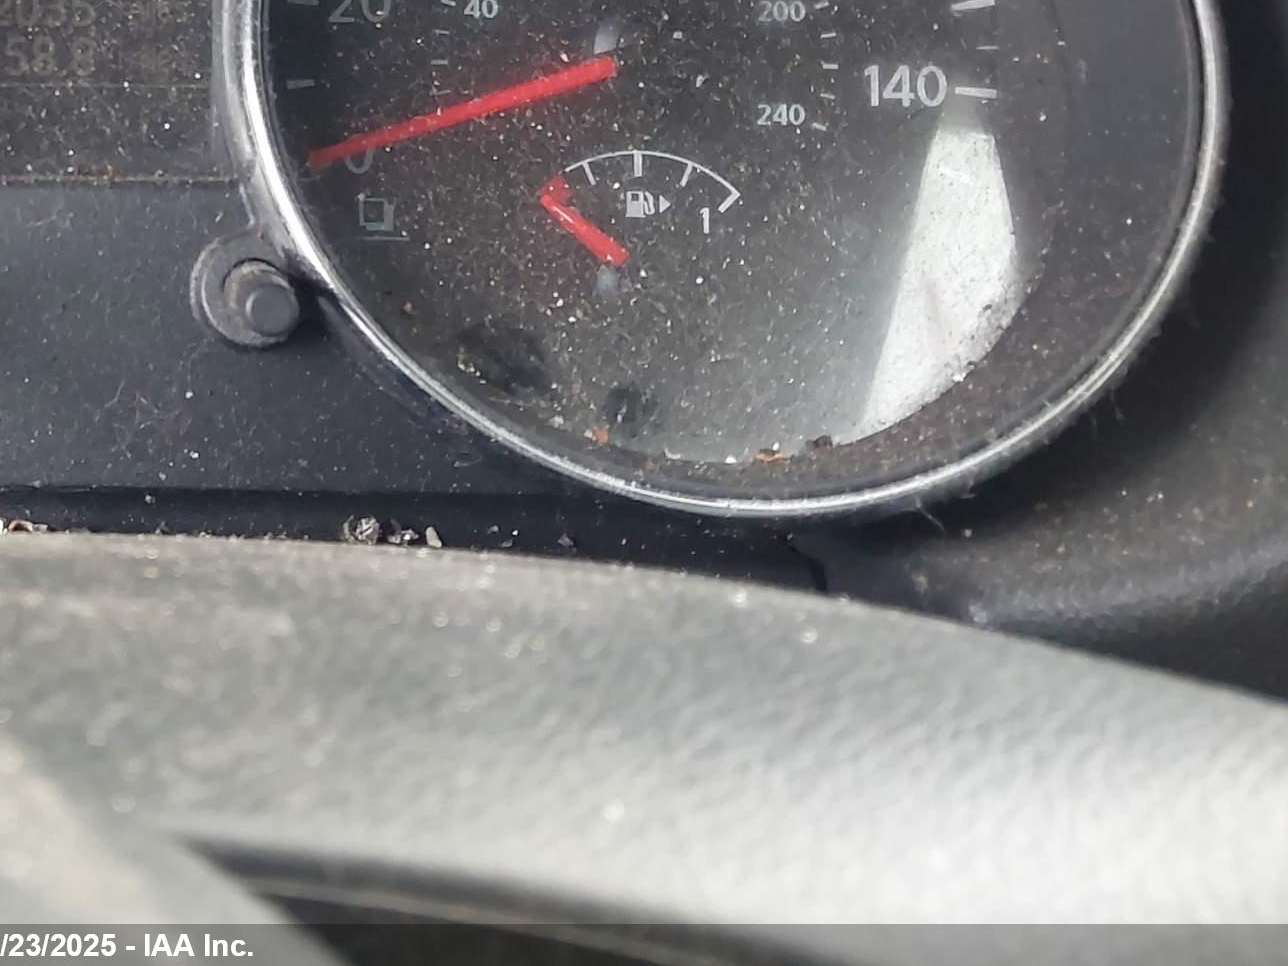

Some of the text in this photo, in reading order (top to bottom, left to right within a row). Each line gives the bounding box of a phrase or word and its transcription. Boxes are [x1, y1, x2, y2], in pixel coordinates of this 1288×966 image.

[758, 0, 806, 23] 200
[864, 65, 948, 108] 140
[757, 103, 806, 126] 240
[699, 207, 710, 235] 1
